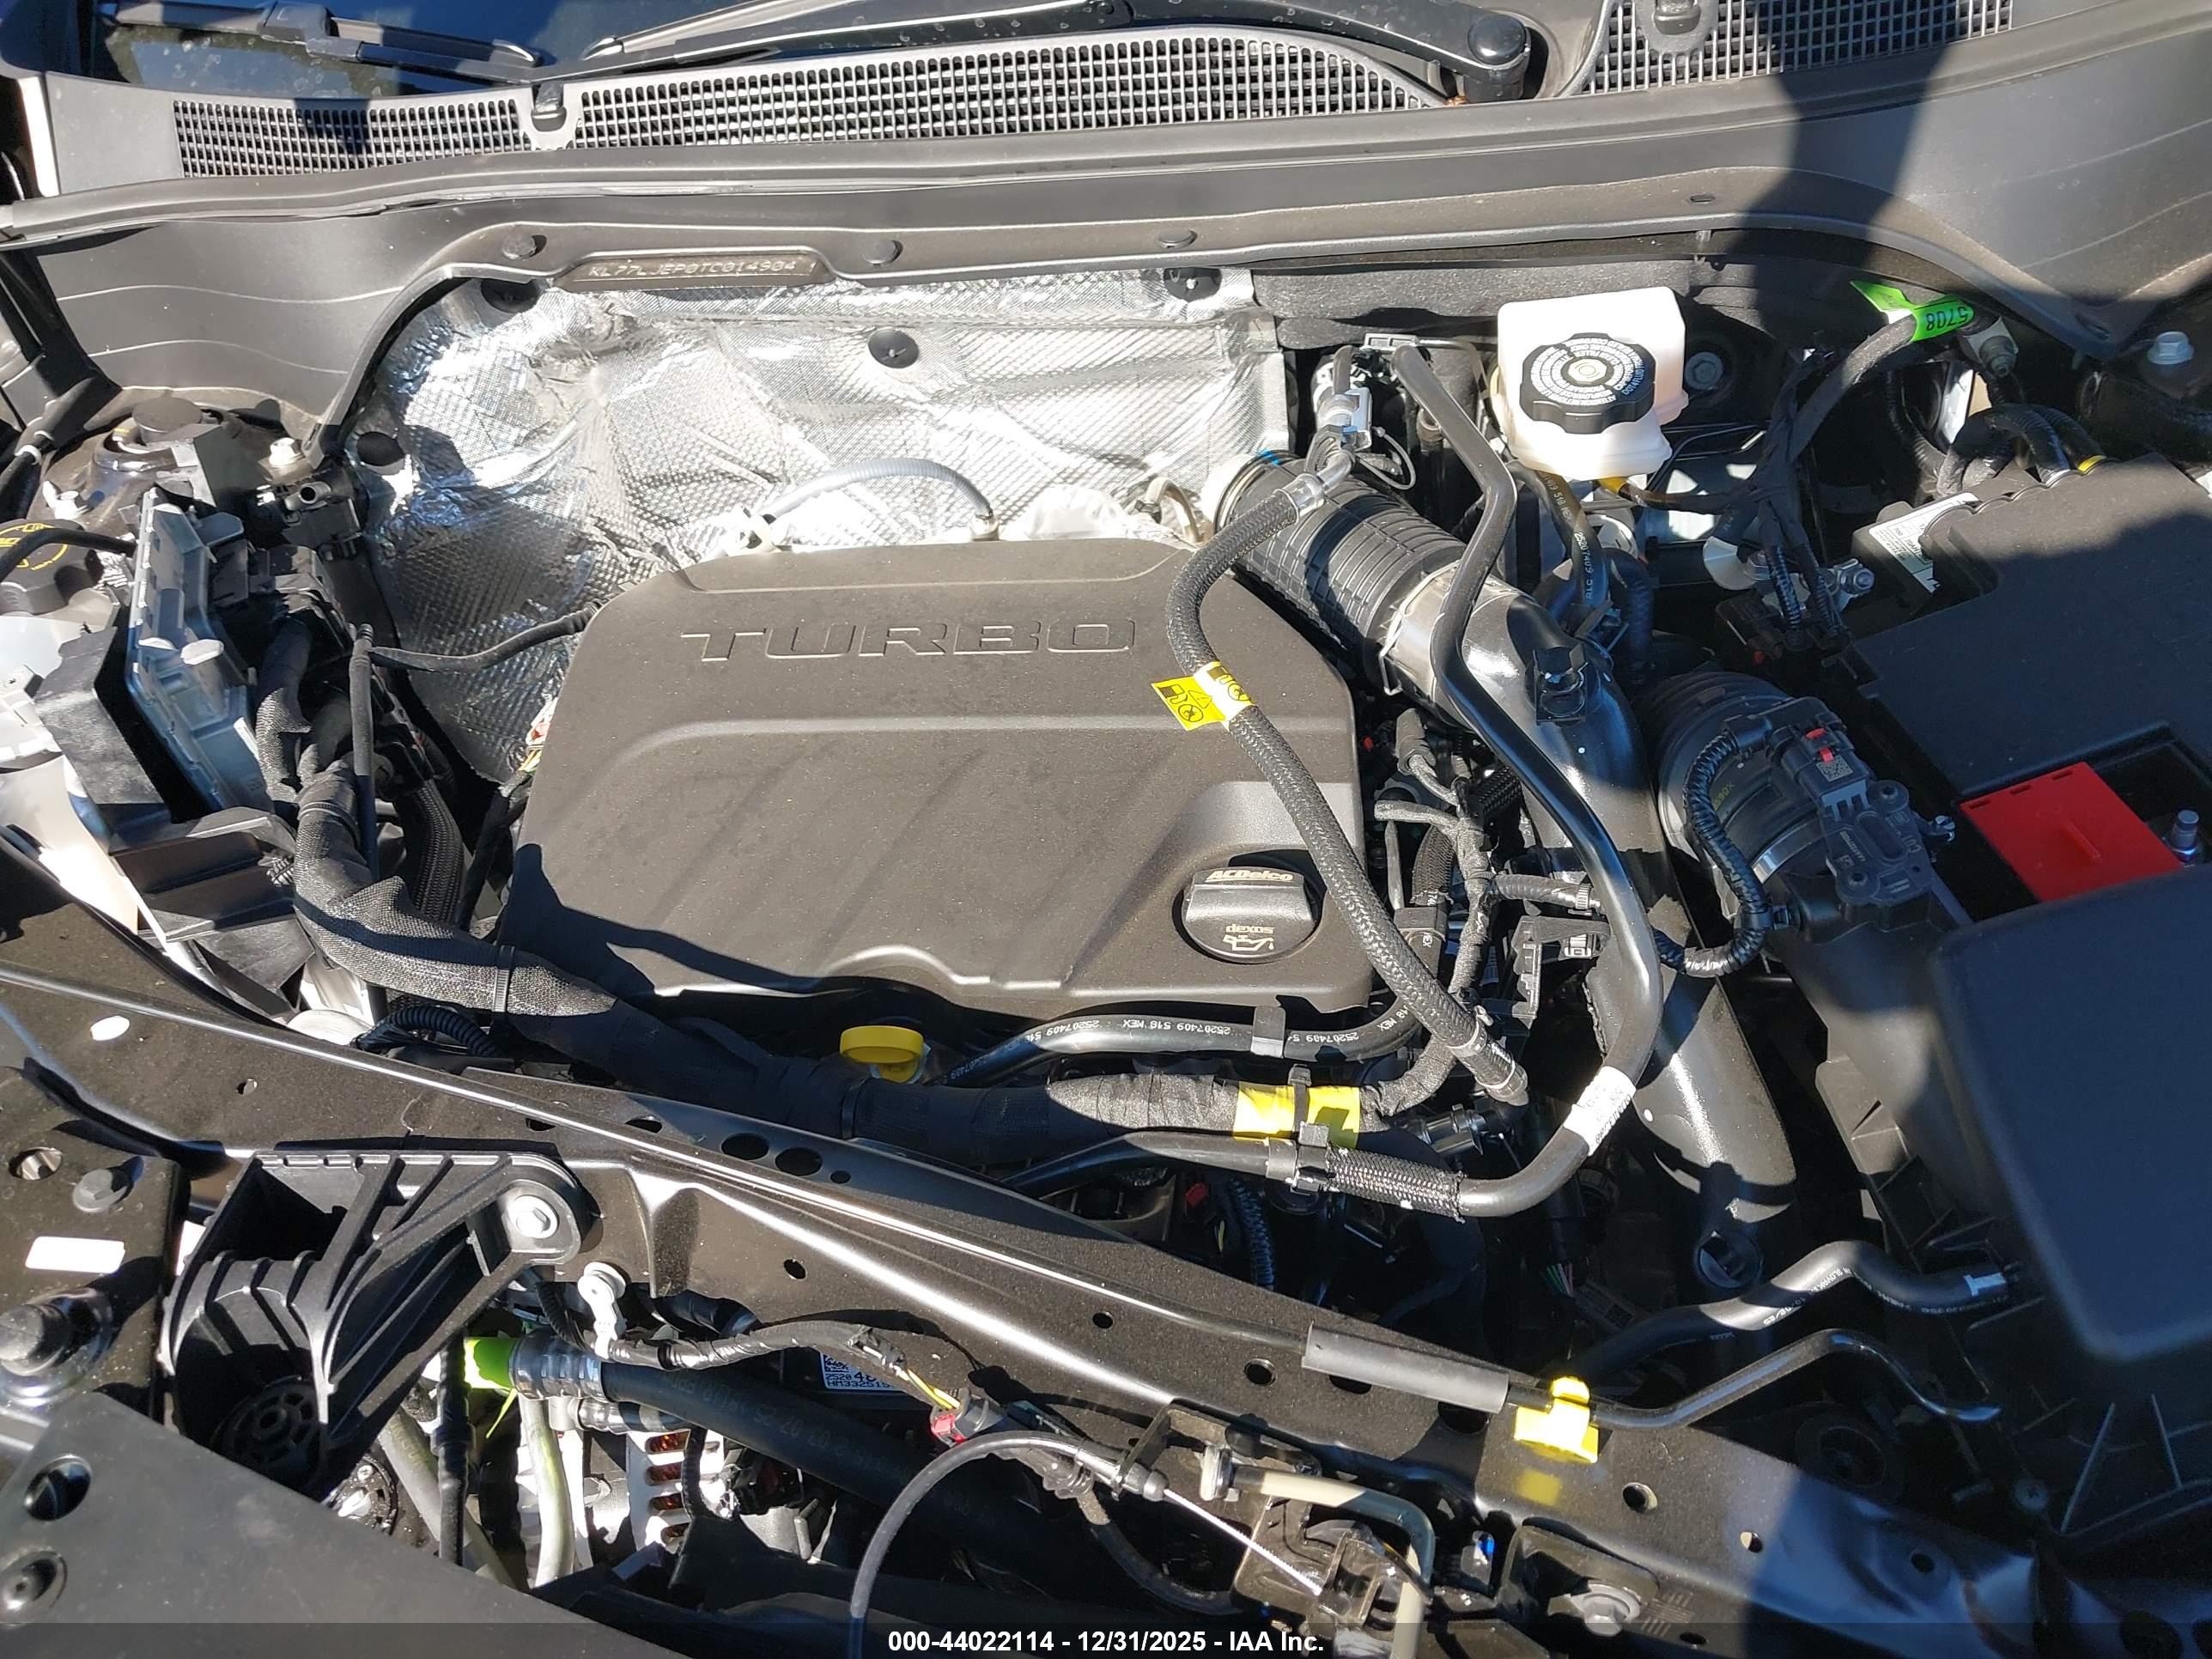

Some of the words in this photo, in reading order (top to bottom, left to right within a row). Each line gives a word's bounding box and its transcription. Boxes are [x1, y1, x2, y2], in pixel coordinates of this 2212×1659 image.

[1925, 306, 1969, 332] 5708
[680, 618, 1136, 662] TURBO
[1205, 870, 1293, 882] ACDelco
[1225, 923, 1275, 934] dexos
[1045, 1019, 1100, 1037] 25207409
[1122, 1018, 1145, 1030] MEX
[1376, 1018, 1397, 1031] MEX
[1305, 1031, 1360, 1044] 25207409
